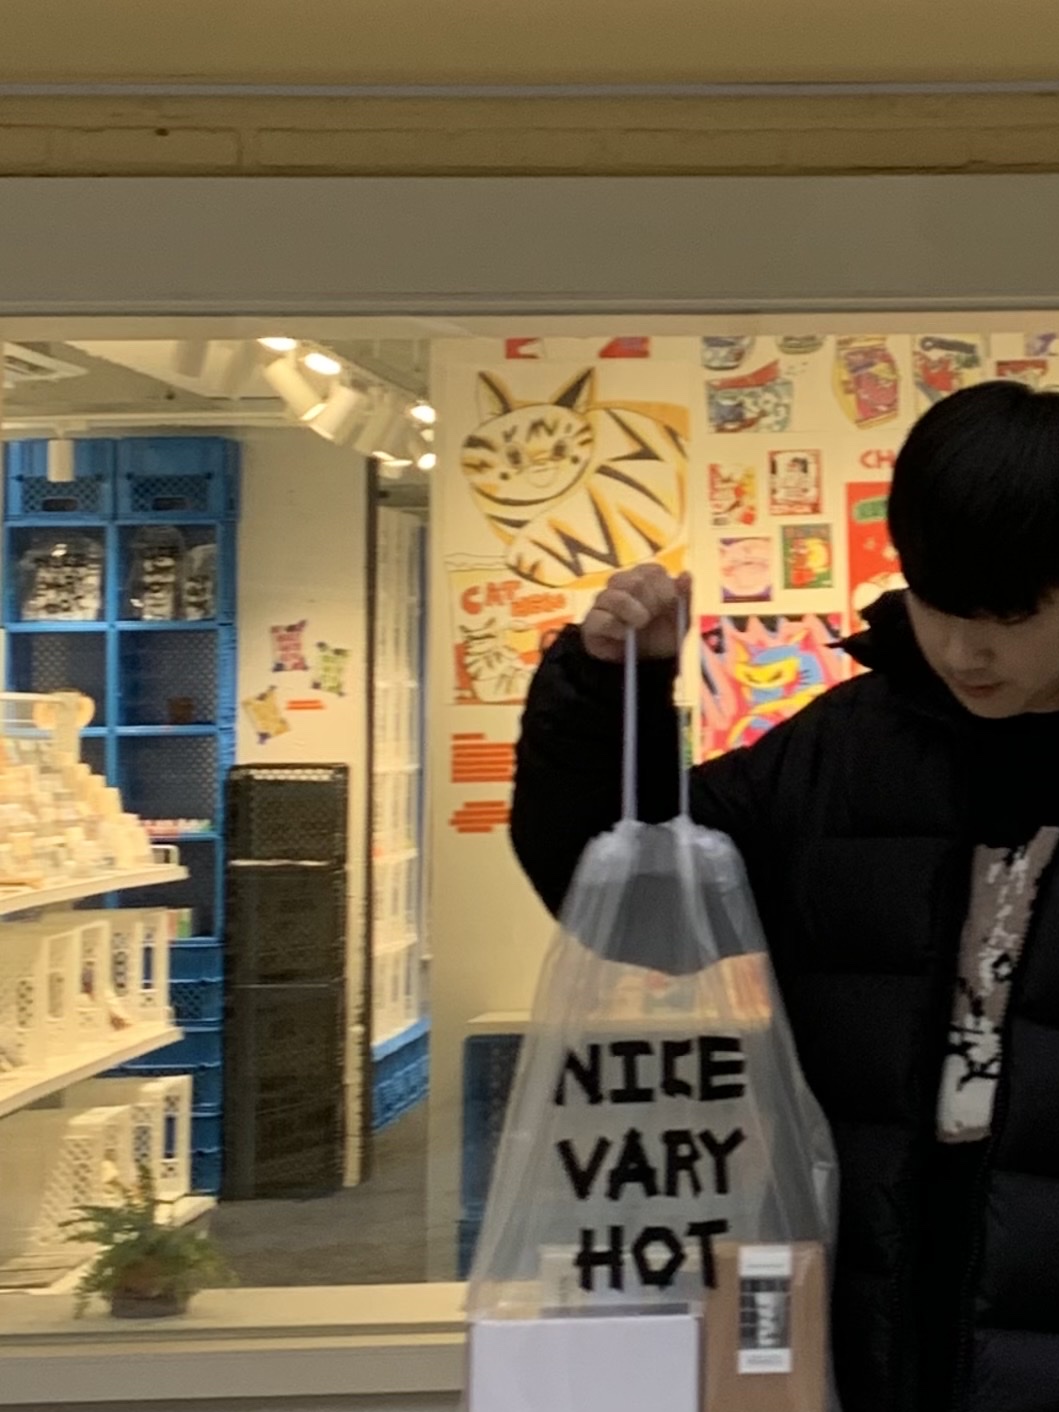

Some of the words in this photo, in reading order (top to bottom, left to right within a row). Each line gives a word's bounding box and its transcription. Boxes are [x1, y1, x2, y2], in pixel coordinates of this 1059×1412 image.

[461, 580, 523, 615] CAT
[553, 1036, 747, 1106] NICE
[556, 1128, 746, 1201] VARY
[574, 1219, 731, 1291] HOT
